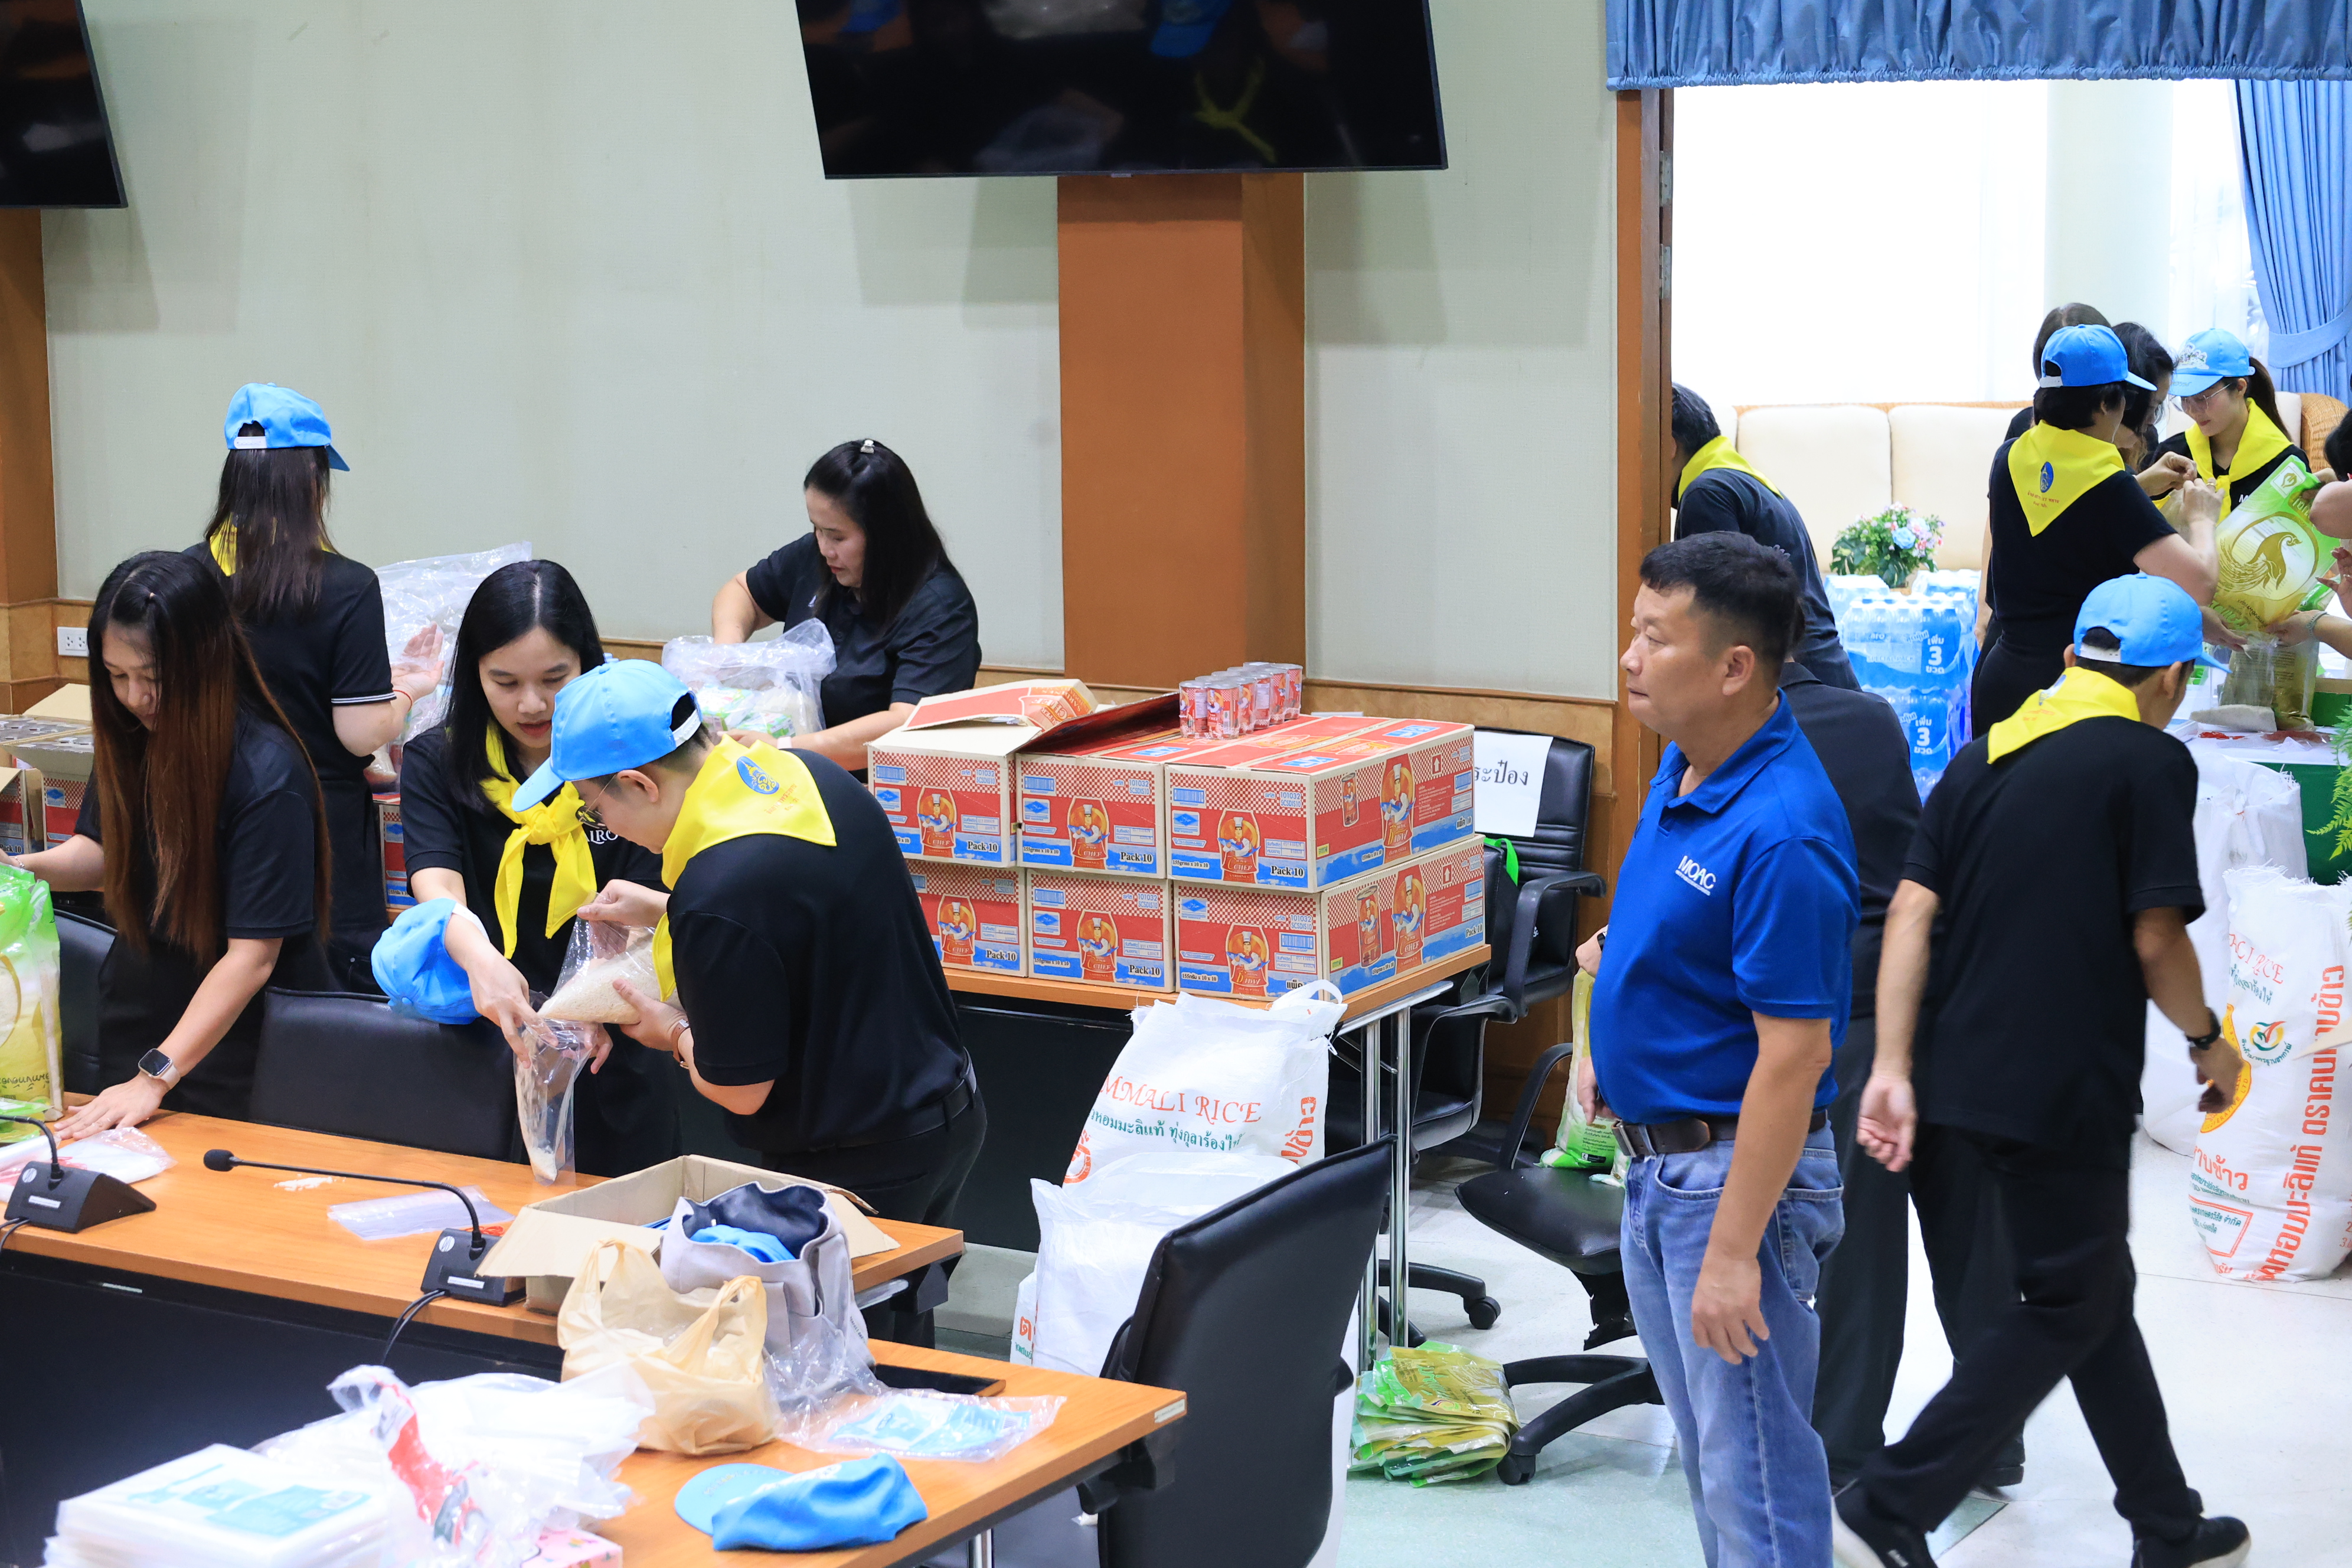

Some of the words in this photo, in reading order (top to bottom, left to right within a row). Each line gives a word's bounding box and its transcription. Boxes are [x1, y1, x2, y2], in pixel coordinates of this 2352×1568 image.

[1928, 646, 1942, 665] 3
[1031, 698, 1067, 720] CHEF
[1041, 707, 1060, 725] SUPER
[1916, 727, 1930, 746] 3
[1129, 787, 1149, 795] SCSDIS10
[1280, 799, 1301, 808] SCSDIS10
[1466, 816, 1472, 824] 10
[584, 829, 619, 845] LRO
[968, 841, 986, 851] Pack
[988, 843, 997, 852] 10
[1121, 852, 1141, 861] Pack
[1142, 854, 1152, 863] 10
[1172, 860, 1190, 868] 155grms
[1272, 865, 1291, 876] Pack
[1293, 867, 1304, 877] 10
[1678, 855, 1716, 889] MOAC
[1291, 914, 1311, 923] 101032
[1291, 922, 1312, 930] SCSDIS10
[1466, 927, 1476, 937] Pack
[1477, 924, 1483, 933] 10
[1404, 941, 1420, 953] CHEF
[986, 950, 1005, 959] Pack
[1007, 953, 1016, 961] 10
[1129, 965, 1148, 975] Pack
[1151, 966, 1160, 976] 10
[2252, 955, 2284, 984] RICE
[2302, 965, 2344, 1135] ตราคนาบข้าว
[1195, 1096, 1262, 1125] RICE
[1089, 1108, 1165, 1137] วหอมมะลิแท้
[1280, 1096, 1317, 1165] บข้าว
[2194, 1145, 2249, 1191] าบข้าว
[2223, 1215, 2242, 1227] จำกัด
